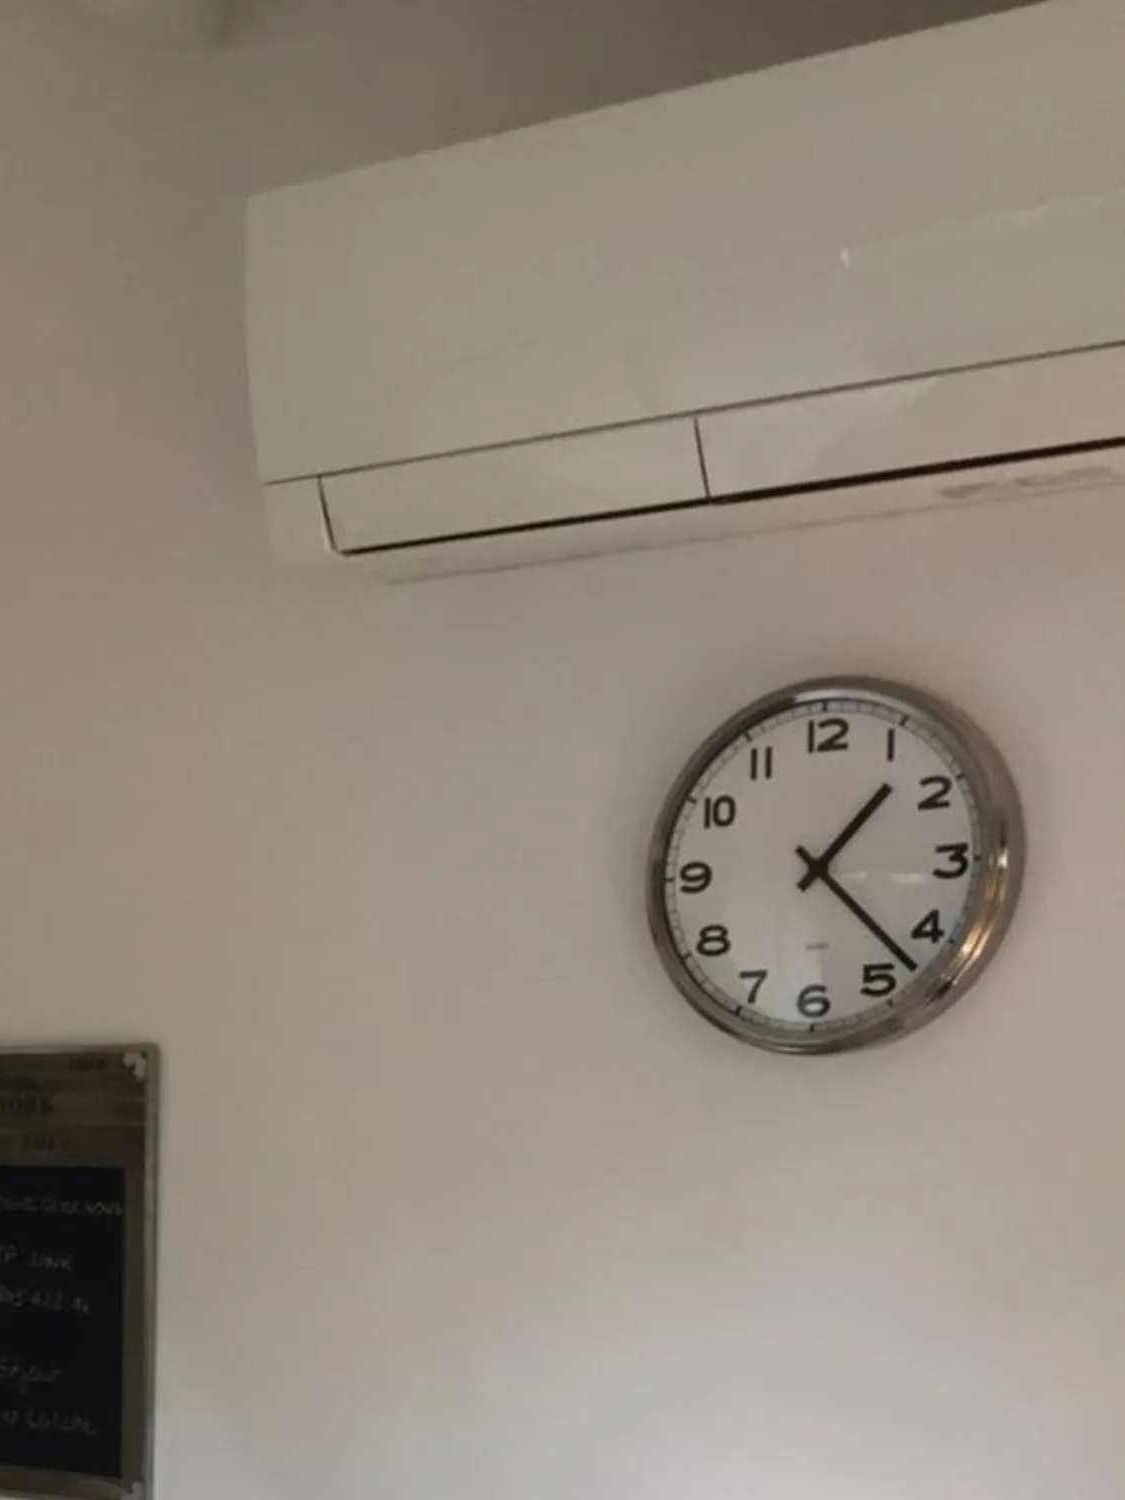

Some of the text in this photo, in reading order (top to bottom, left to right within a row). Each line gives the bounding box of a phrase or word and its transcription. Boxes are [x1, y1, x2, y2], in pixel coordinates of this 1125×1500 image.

[807, 718, 849, 753] 12
[887, 728, 895, 763] 1
[750, 746, 773, 780] 11
[917, 775, 952, 811] 2
[703, 795, 736, 829] 10
[679, 861, 713, 894] 9
[932, 843, 969, 879] 3
[696, 924, 731, 957] 8
[910, 909, 945, 944] 4
[739, 970, 768, 1004] 7
[859, 963, 897, 996] 5
[796, 984, 831, 1018] 6
